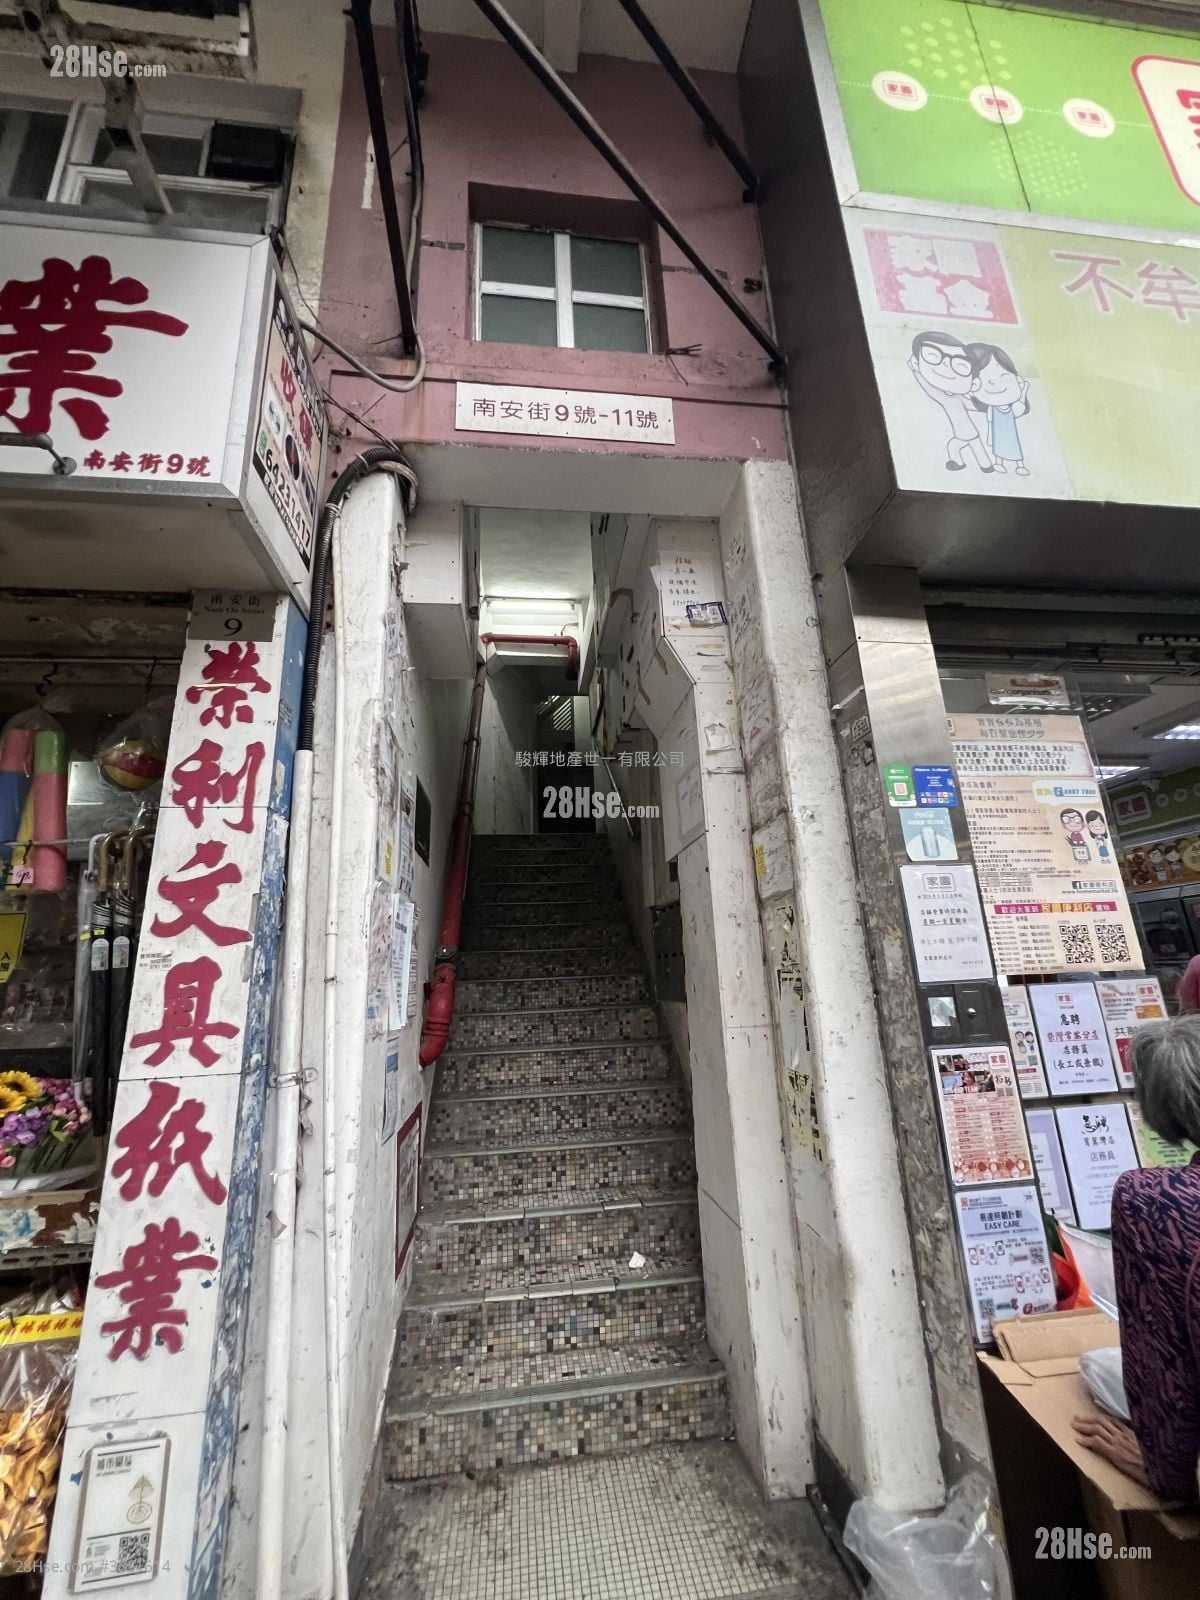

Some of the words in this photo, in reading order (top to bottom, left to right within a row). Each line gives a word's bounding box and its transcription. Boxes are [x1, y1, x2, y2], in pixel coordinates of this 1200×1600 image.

[472, 398, 659, 430] 南安街9號-11號
[82, 449, 212, 478] 南安街9號
[223, 617, 243, 637] 9
[984, 1221, 1001, 1231] EASY
[1003, 1219, 1021, 1229] CARE
